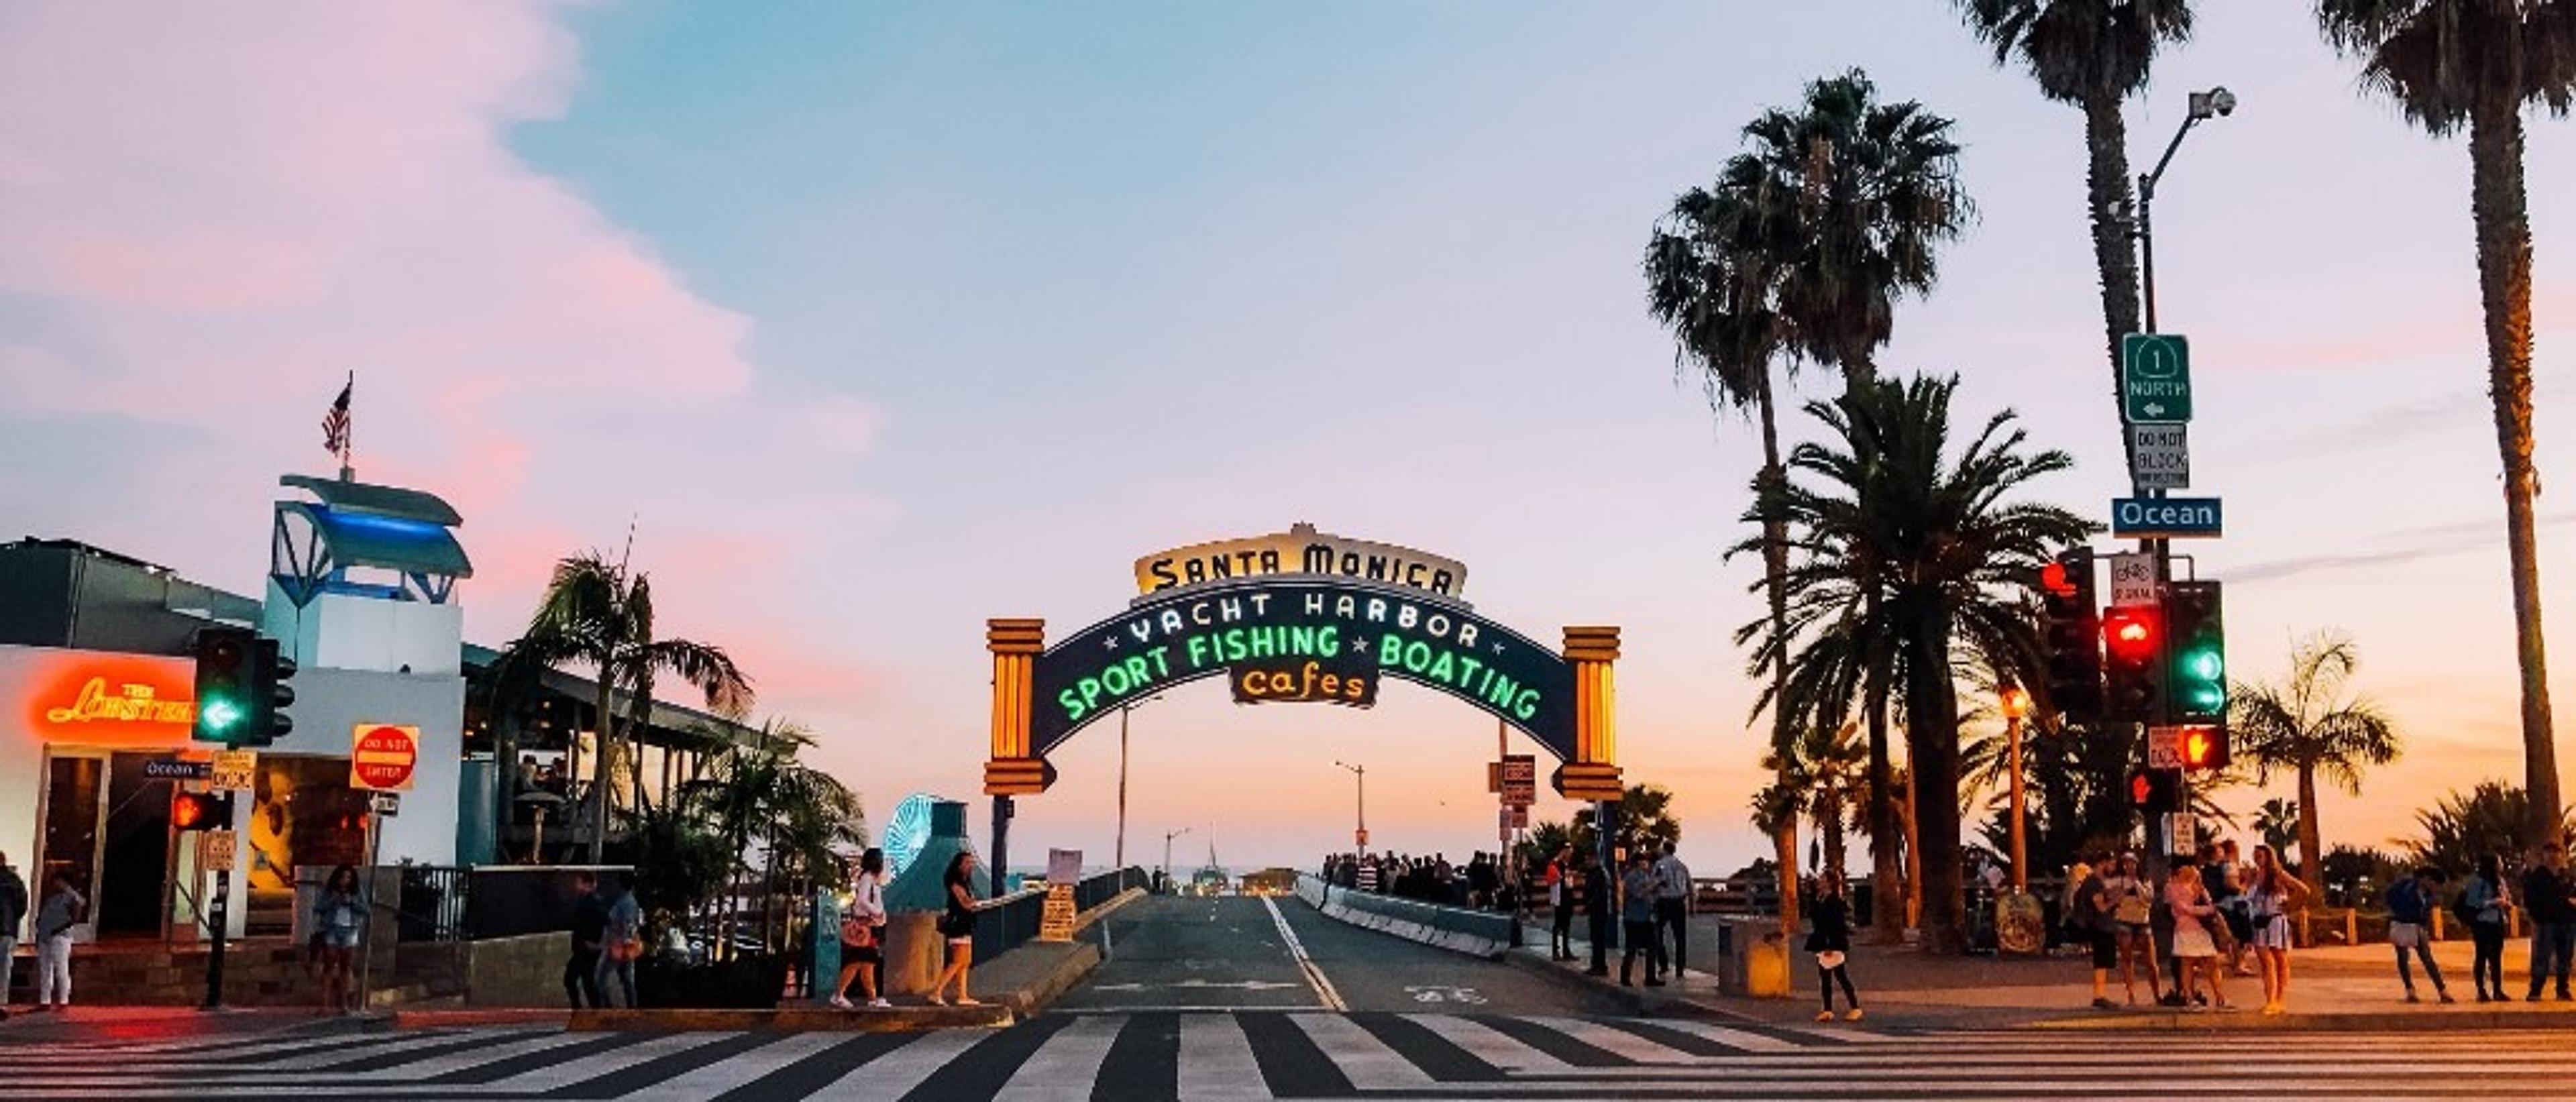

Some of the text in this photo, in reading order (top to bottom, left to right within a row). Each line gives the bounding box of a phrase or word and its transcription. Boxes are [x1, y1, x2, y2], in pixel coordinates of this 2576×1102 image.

[2153, 349, 2159, 370] 1
[2130, 381, 2187, 396] NORTH
[2138, 432, 2184, 447] DO NOT
[2138, 452, 2186, 469] BLOCK
[2121, 502, 2213, 525] Ocean
[1150, 544, 1452, 595] SANTA MONICA
[1130, 593, 1479, 648] YACHT HARBOR
[1058, 625, 1340, 720] SPORT FISHING
[1242, 661, 1364, 698] cafes
[1379, 633, 1541, 720] BOATING
[364, 739, 409, 751] DO NOT
[147, 762, 193, 775] Ocean
[366, 766, 401, 778] ENTER
